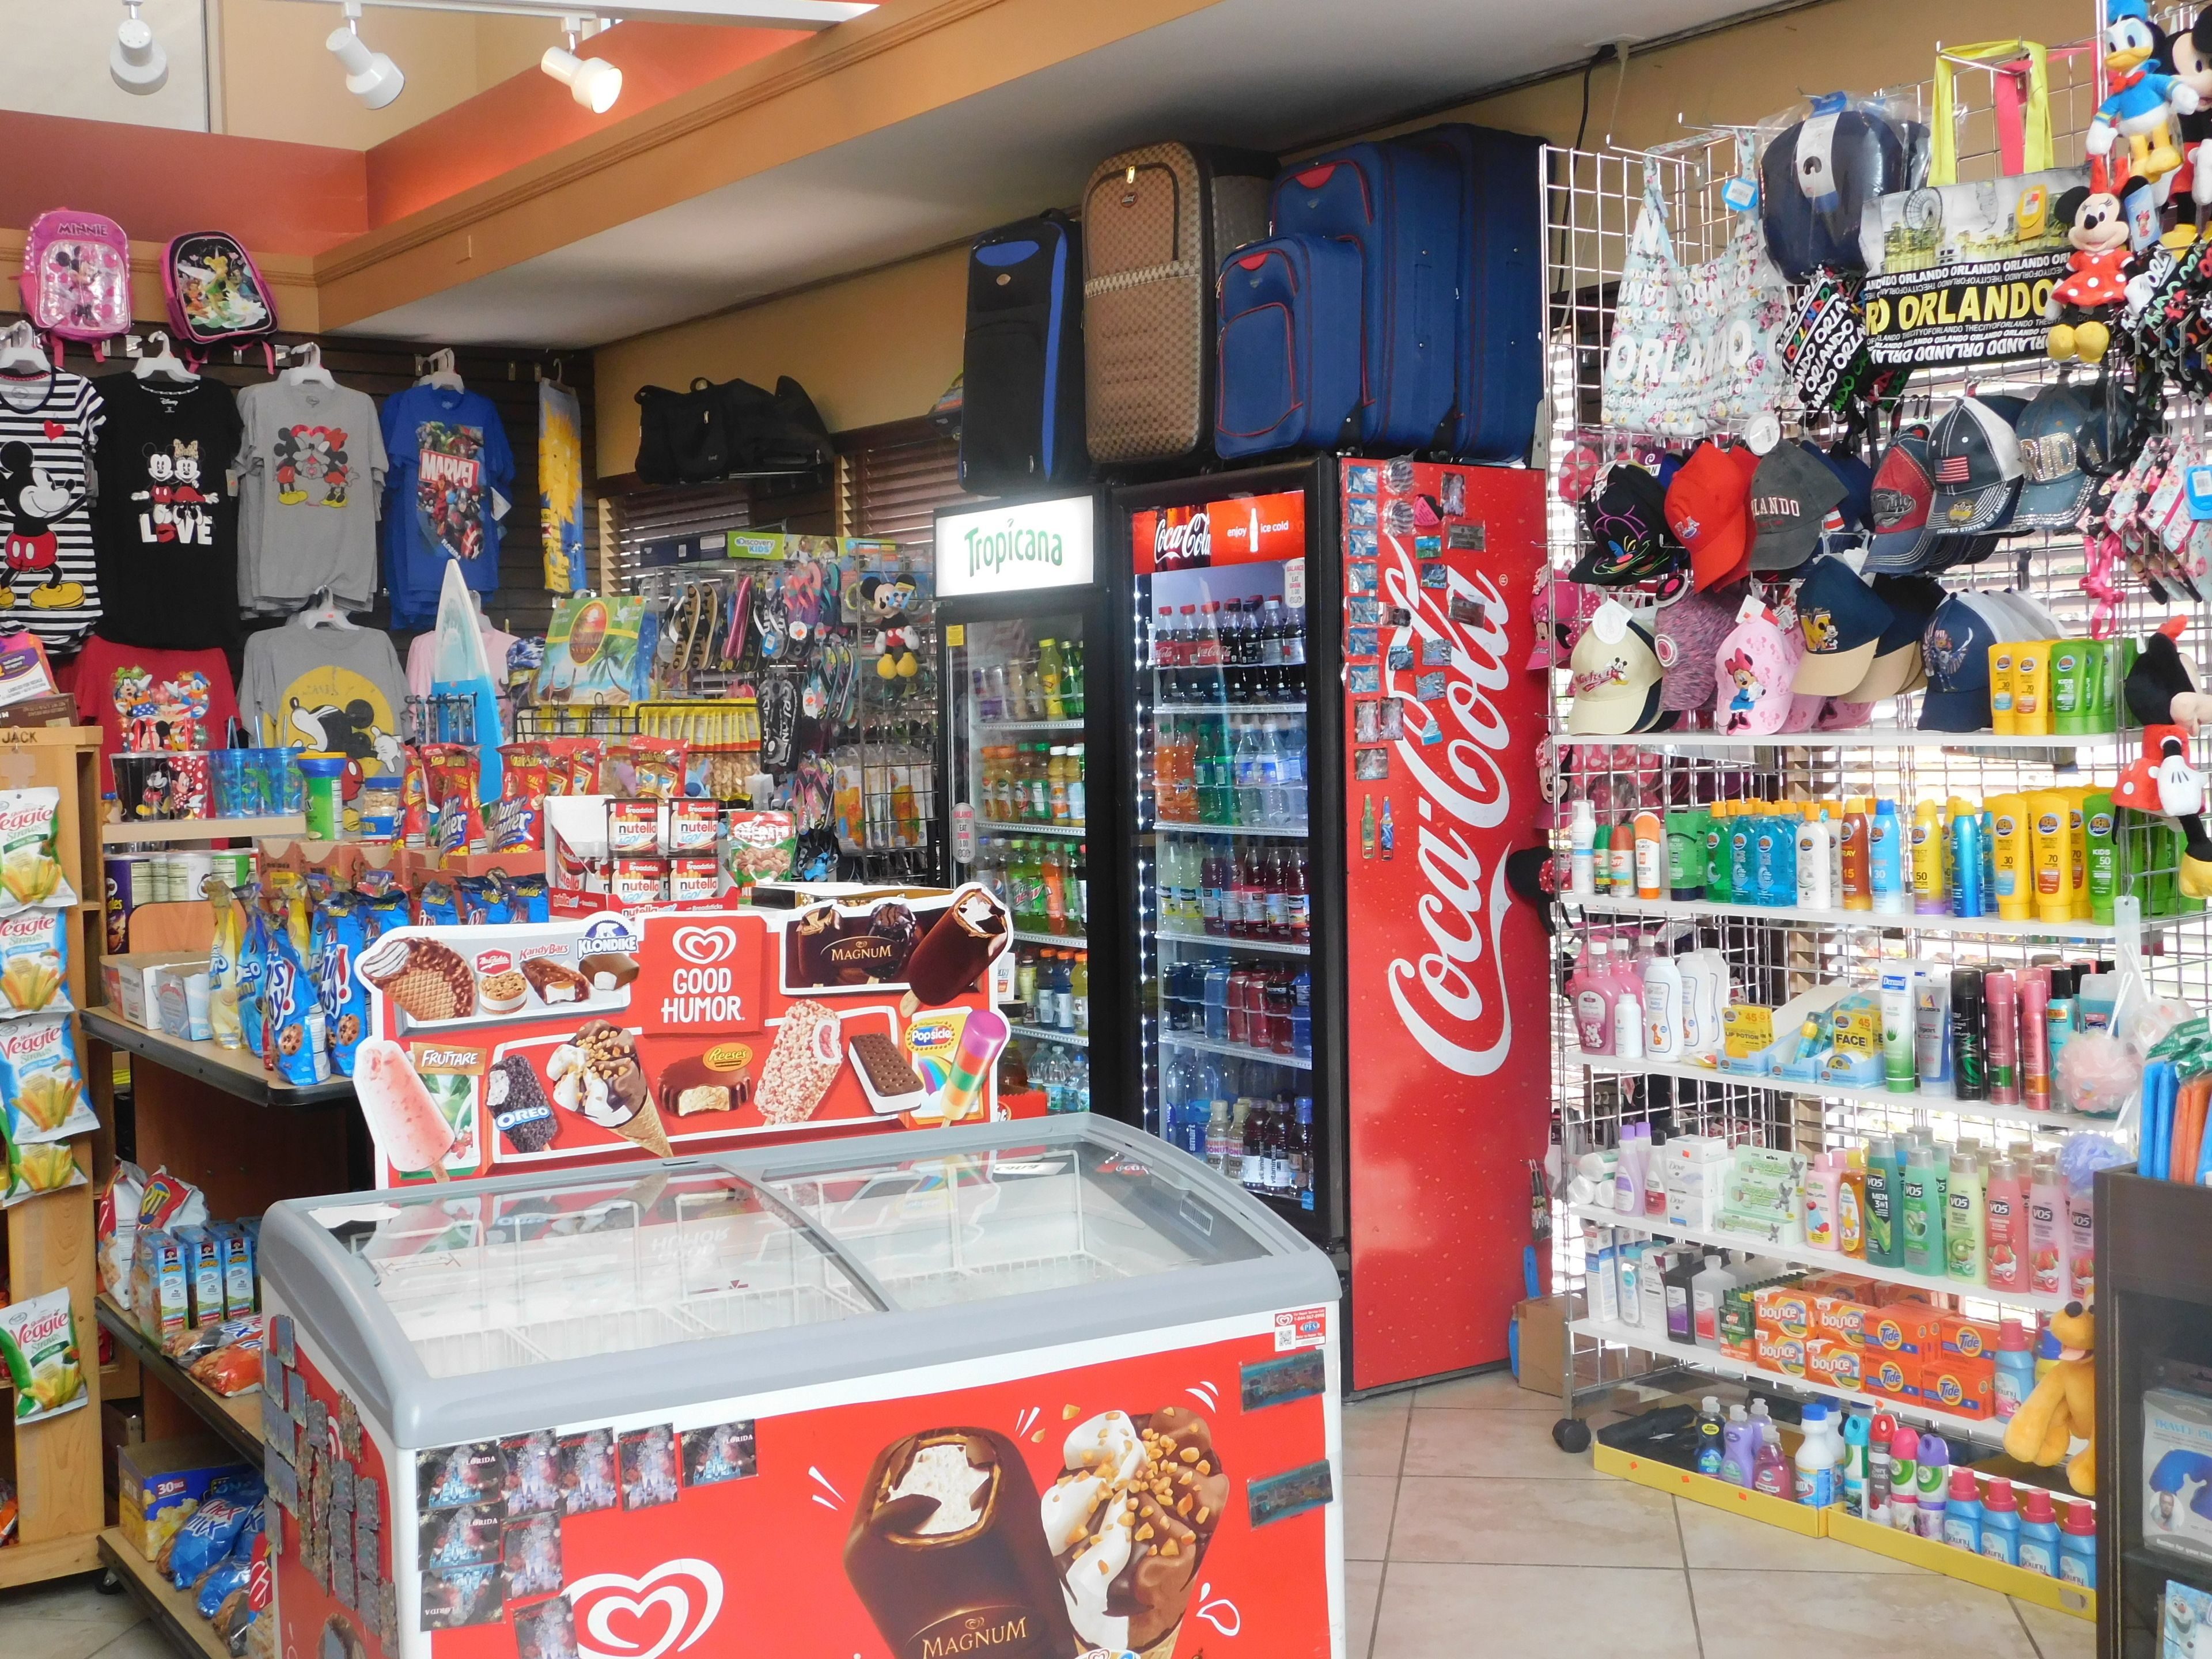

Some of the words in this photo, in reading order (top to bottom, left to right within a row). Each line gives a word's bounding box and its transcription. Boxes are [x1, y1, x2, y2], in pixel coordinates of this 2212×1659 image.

[58, 222, 108, 237] MINNIE
[1899, 268, 1948, 283] ORLANDO
[1950, 261, 2000, 277] ORLANDO
[2003, 255, 2048, 271] ORLANDO
[1898, 279, 2056, 331] ORLANDO
[1964, 320, 2033, 332] THECITYOFORLANDO
[1960, 522, 1987, 532] STATES
[1987, 512, 1995, 522] OF
[1995, 487, 2012, 519] AMERICA
[1227, 527, 1247, 537] enjoy
[1260, 524, 1271, 533] ice
[1272, 520, 1289, 531] cold
[738, 538, 775, 548] Discovery
[1154, 513, 1211, 564] Coca-Cola
[749, 545, 770, 553] KIDS
[964, 519, 1062, 578] Tropicana
[2, 732, 37, 744] JACK
[1385, 535, 1512, 1076] Coca-Cola
[619, 823, 657, 834] nutella
[681, 821, 717, 833] nutella
[2048, 854, 2058, 863] 70
[2072, 850, 2082, 858] 70
[1611, 858, 1623, 866] OFF!
[2003, 857, 2013, 865] 30
[2099, 857, 2111, 865] 50
[1874, 870, 1885, 878] 30
[1916, 872, 1927, 881] 50
[622, 880, 659, 892] nutella
[680, 878, 717, 890] nutella
[578, 936, 638, 960] KLONDIKE
[831, 945, 892, 961] MAGNUM
[673, 969, 732, 994] GOOD
[661, 995, 741, 1023] HUMOR
[1745, 1013, 1757, 1022] 45
[1858, 1018, 1870, 1028] 45
[911, 1027, 952, 1043] Popsicle
[1836, 1034, 1866, 1047] FACE
[0, 1028, 61, 1059] Veggie
[421, 1050, 478, 1067] FRUTTARE
[709, 1048, 747, 1062] Reese's
[497, 1106, 550, 1128] OREO
[1669, 1161, 1685, 1171] Dove
[1866, 1177, 1883, 1187] VO5
[1872, 1192, 1888, 1200] MEN
[1904, 1184, 1922, 1196] VO5
[1670, 1195, 1685, 1205] Dove
[1949, 1196, 1967, 1207] VO5
[1990, 1203, 2008, 1214] VO5
[2032, 1209, 2051, 1220] VO5
[2071, 1215, 2090, 1226] VO5
[1759, 1304, 1798, 1320] bounce
[1821, 1312, 1860, 1328] bounce
[9, 1309, 69, 1345] Veggie
[1880, 1328, 1899, 1343] Tide
[1958, 1334, 1979, 1349] Tide
[1759, 1343, 1798, 1359] bounce
[1810, 1357, 1852, 1374] bounce
[1882, 1369, 1902, 1384] Tide
[1939, 1384, 1960, 1399] Tide
[157, 1481, 174, 1495] 30
[1946, 1533, 1970, 1548] Downy
[2022, 1559, 2047, 1573] Downy
[922, 1616, 1027, 1659] MAGNUM
